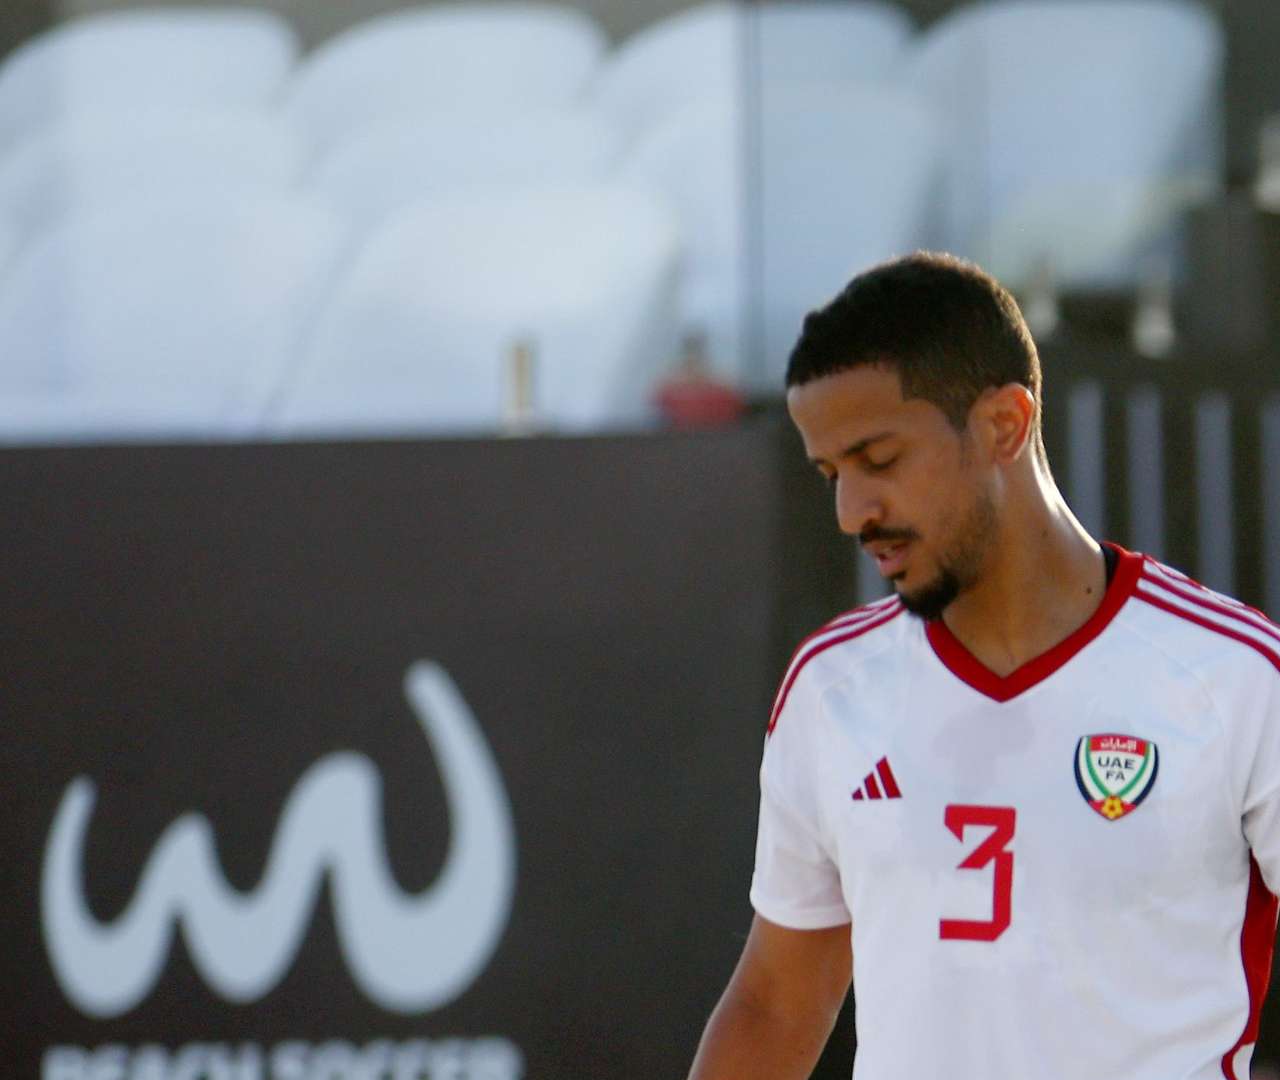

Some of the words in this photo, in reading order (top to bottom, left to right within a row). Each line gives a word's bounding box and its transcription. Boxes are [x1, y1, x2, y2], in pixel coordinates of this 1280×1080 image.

[1098, 756, 1136, 770] UAE
[1105, 770, 1126, 781] FA
[940, 805, 1016, 942] 3
